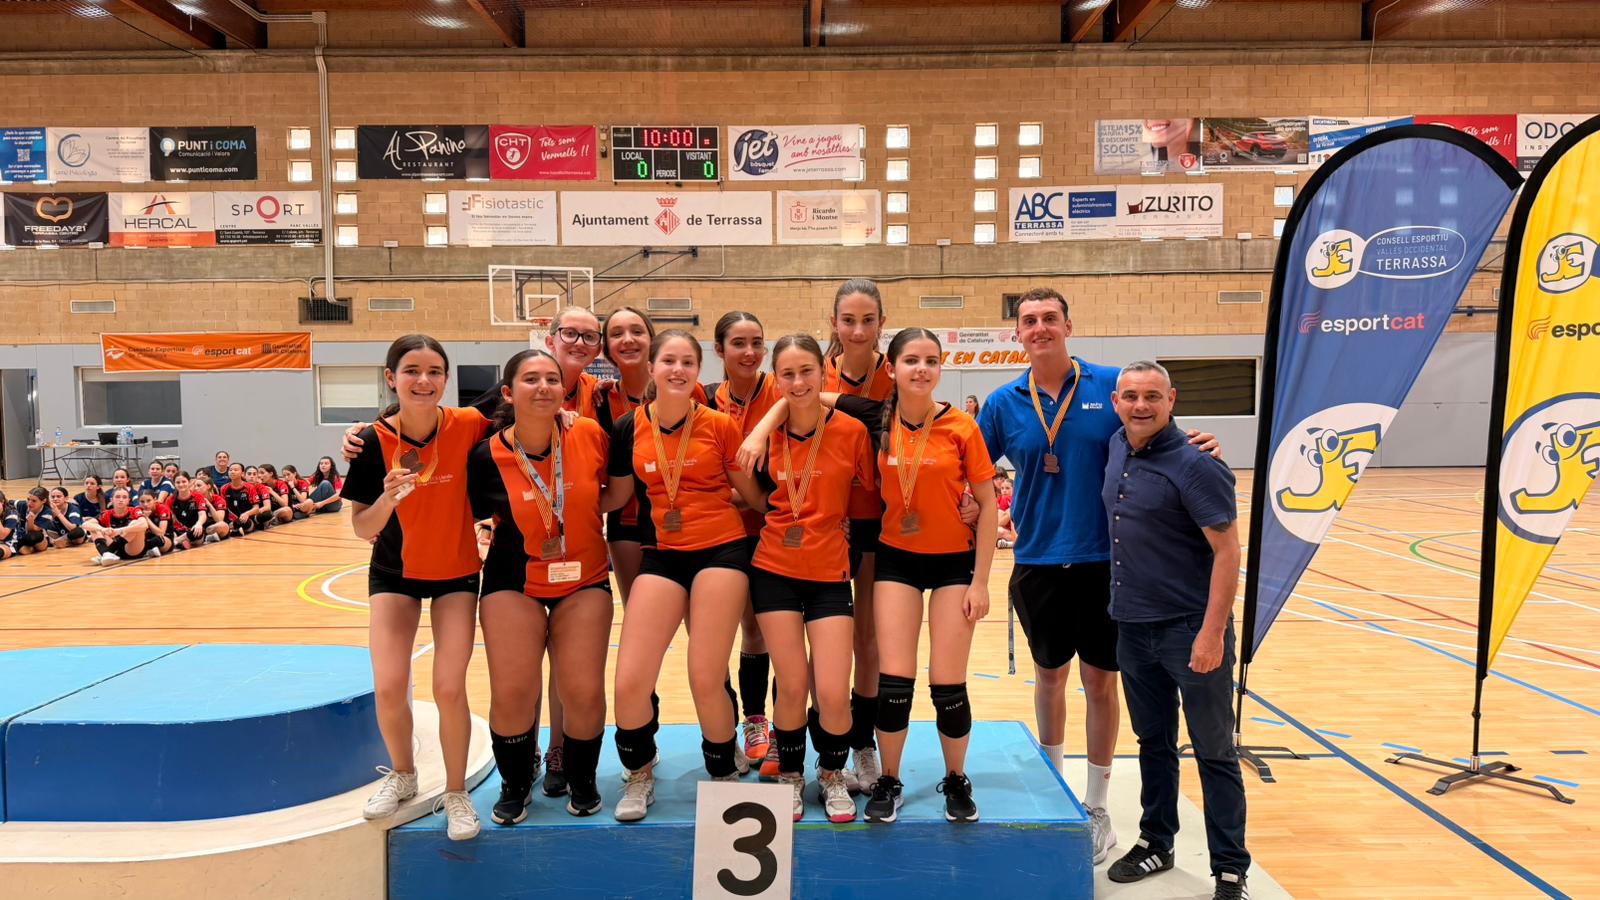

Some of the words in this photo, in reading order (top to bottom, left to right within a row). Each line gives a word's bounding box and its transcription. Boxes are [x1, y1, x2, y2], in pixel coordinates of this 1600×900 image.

[1481, 126, 1499, 134] som
[1525, 122, 1576, 139] ODO
[499, 138, 527, 147] CHT
[539, 137, 555, 147] Tots
[558, 137, 576, 146] som
[644, 129, 693, 146] 10:00
[178, 140, 208, 150] PUNT
[210, 140, 213, 150] i
[215, 139, 247, 150] COMA
[383, 131, 402, 170] Al
[404, 131, 466, 160] Panino
[734, 130, 778, 171] jet
[1103, 144, 1136, 154] SOCIS
[541, 147, 577, 160] Vermells
[621, 151, 644, 160] LOCAL
[685, 152, 712, 160] VISITANT
[169, 165, 239, 173] www.punticoma.com
[637, 161, 648, 178] 0
[655, 169, 677, 178] PERIODE
[703, 161, 714, 178] 0
[471, 194, 544, 209] Fisiotastic
[1015, 192, 1064, 221] ABC
[1145, 195, 1213, 212] ZURITO
[124, 218, 198, 229] HERCAL
[572, 214, 649, 226] Ajuntament
[686, 214, 703, 226] de
[706, 214, 762, 226] Terrassa
[1016, 222, 1063, 230] TERRASSA
[1376, 236, 1410, 245] CONSELL
[1411, 233, 1449, 243] ESPORTIU
[1404, 244, 1448, 253] OCCIDENTAL
[1376, 255, 1447, 270] TERRASSA
[1321, 313, 1425, 335] esportcat
[1551, 322, 1600, 341] espo
[205, 346, 251, 357] esportcat
[953, 351, 975, 365] EN
[979, 350, 1032, 365] CATAL
[717, 802, 777, 896] 3
